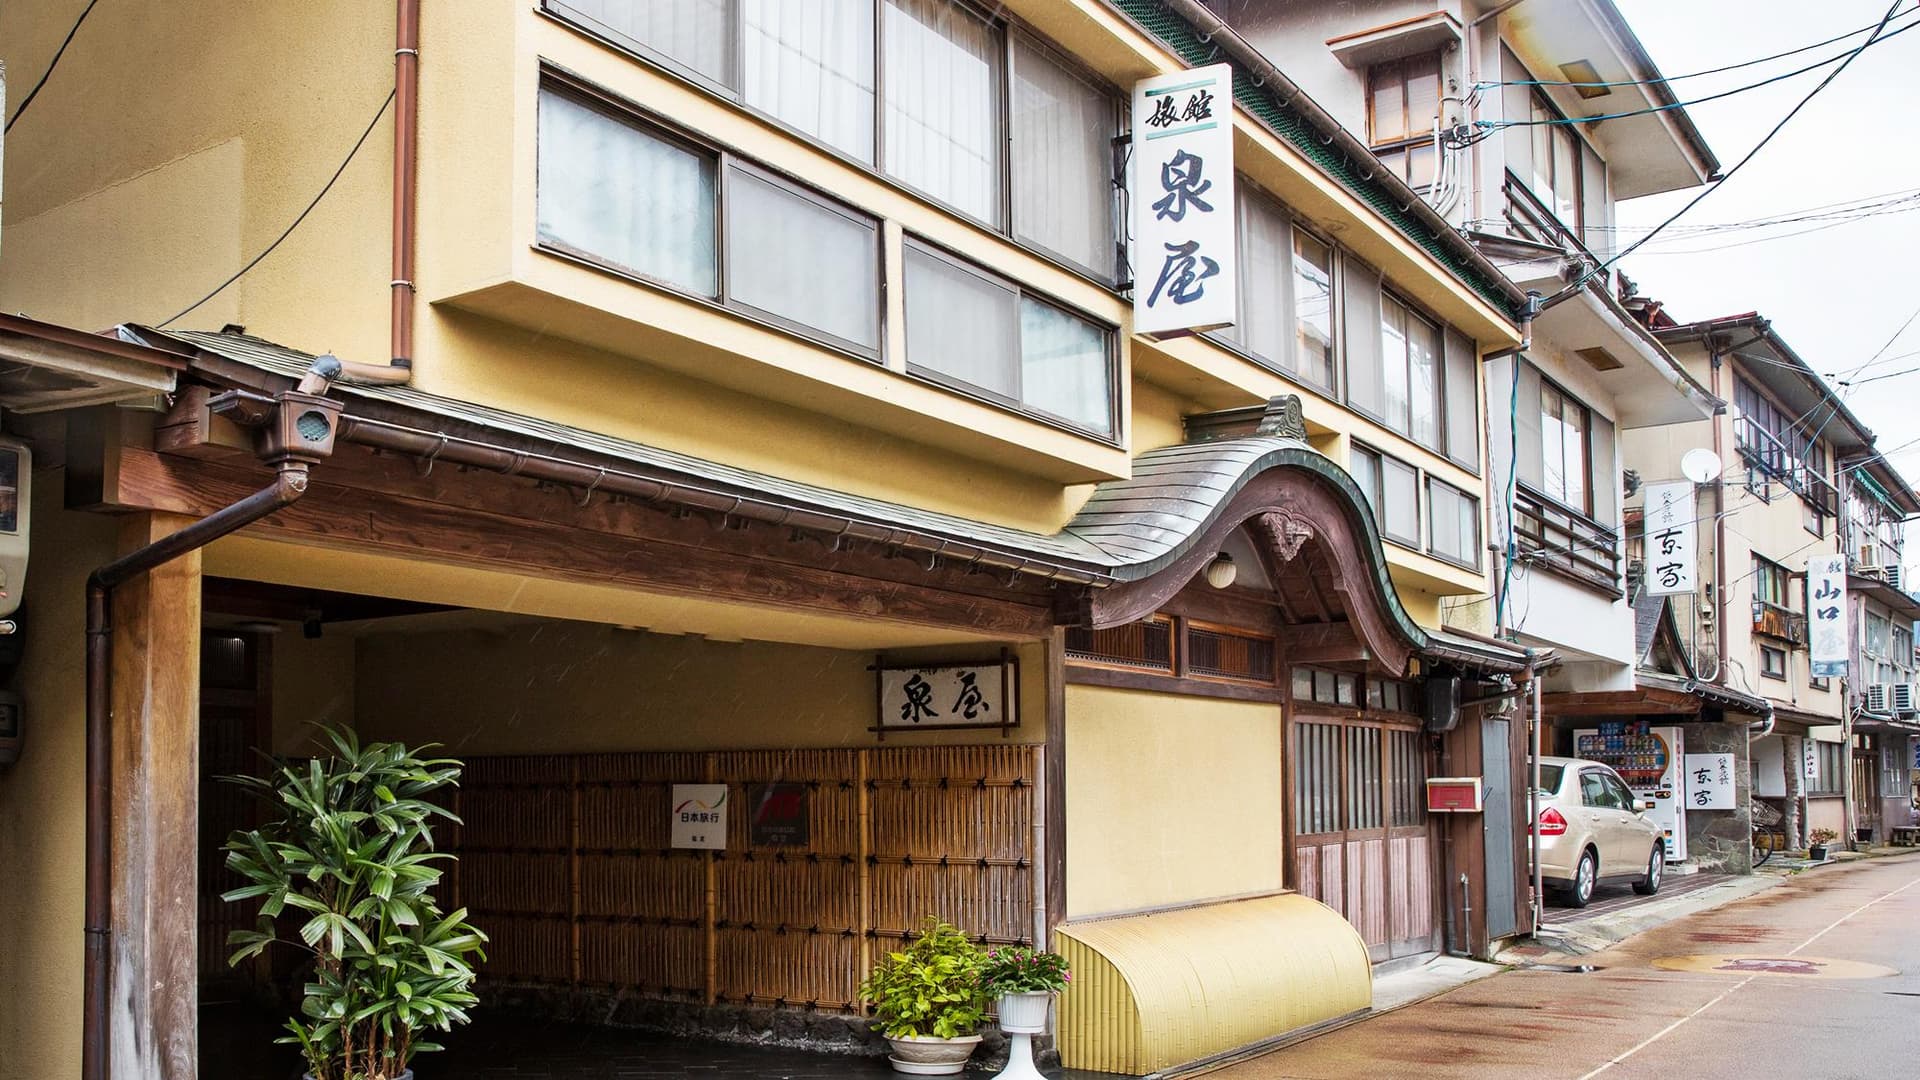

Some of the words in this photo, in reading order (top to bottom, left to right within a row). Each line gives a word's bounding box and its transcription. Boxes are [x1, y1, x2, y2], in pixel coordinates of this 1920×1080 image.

[1145, 89, 1215, 128] 旅館
[1146, 149, 1220, 309] 泉屋
[901, 671, 989, 723] 泉屋
[681, 812, 719, 823] 日本旅行
